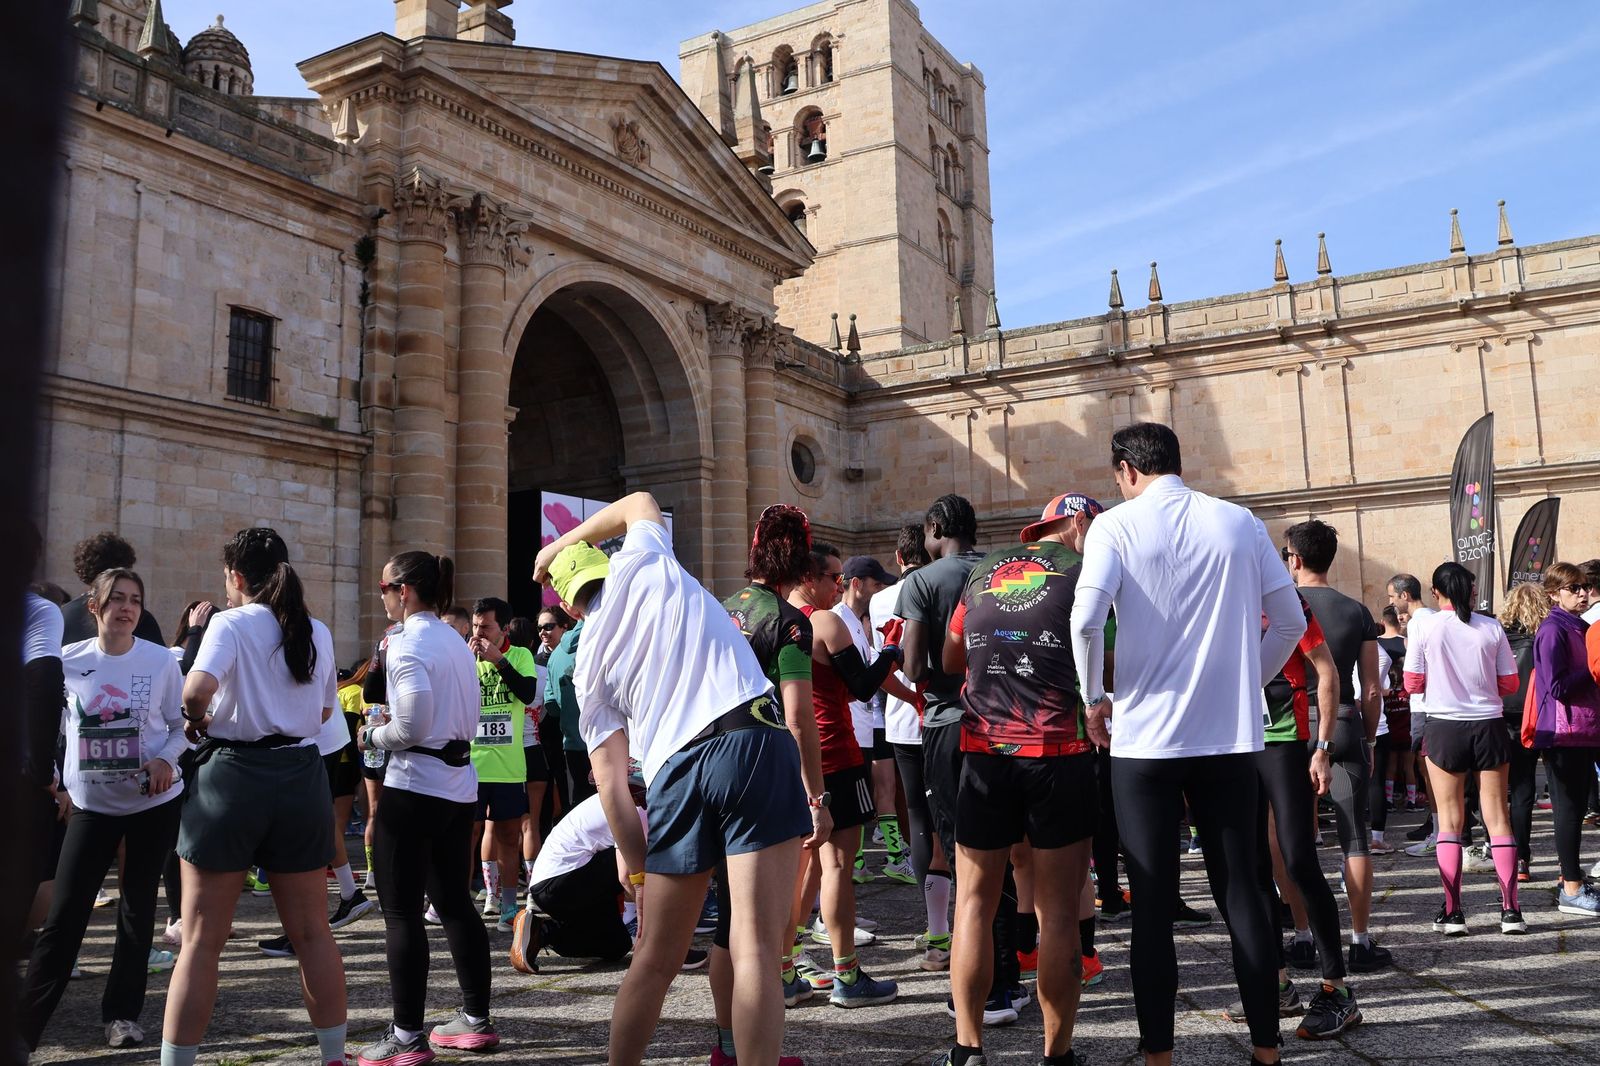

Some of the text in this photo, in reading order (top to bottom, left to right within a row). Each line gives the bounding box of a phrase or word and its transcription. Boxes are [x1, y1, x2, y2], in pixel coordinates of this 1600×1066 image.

[1064, 496, 1087, 504] RUN
[1064, 508, 1077, 516] HE
[985, 556, 1051, 584] LA RAYA TRAIL
[999, 590, 1048, 612] ALCAÑICES
[736, 611, 746, 626] TRAIL
[480, 693, 507, 706] TRAIL
[482, 722, 506, 736] 183
[90, 738, 129, 758] 616
